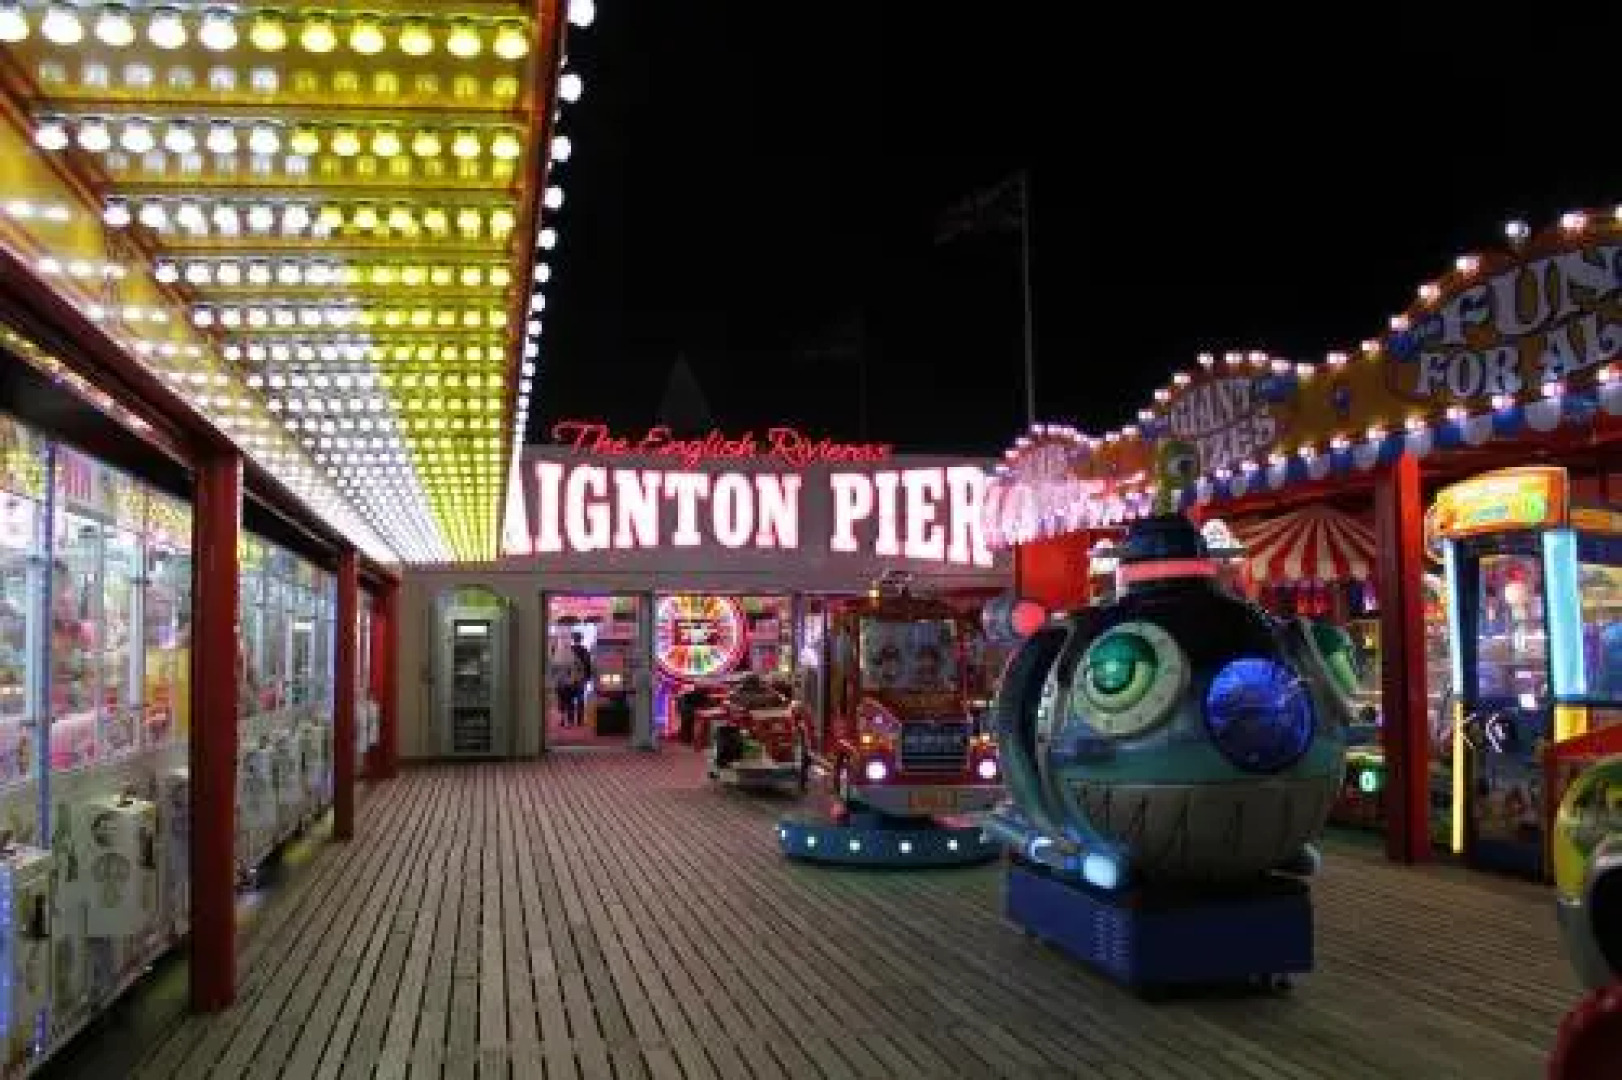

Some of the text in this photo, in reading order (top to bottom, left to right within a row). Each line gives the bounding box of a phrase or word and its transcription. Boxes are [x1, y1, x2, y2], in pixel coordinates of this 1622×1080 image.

[1413, 347, 1523, 396] FOR
[552, 421, 627, 454] The
[638, 427, 756, 470] English
[830, 466, 993, 567] PIER
